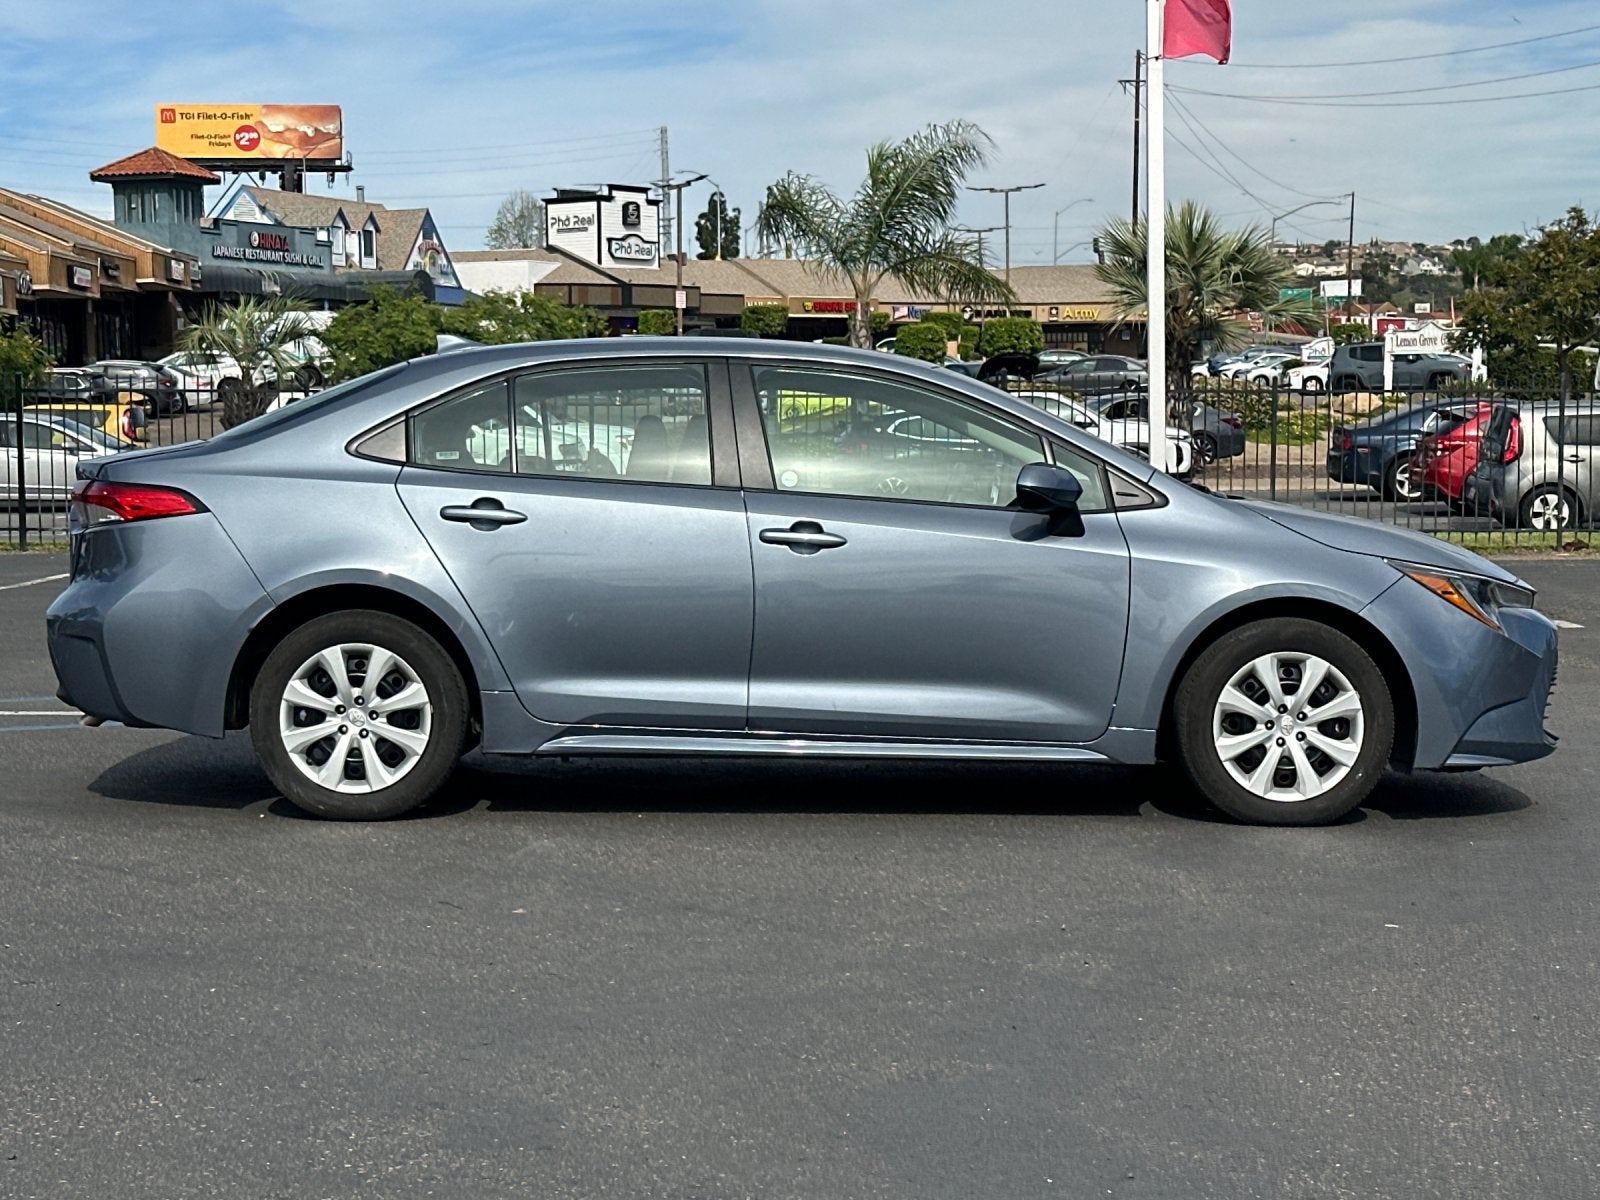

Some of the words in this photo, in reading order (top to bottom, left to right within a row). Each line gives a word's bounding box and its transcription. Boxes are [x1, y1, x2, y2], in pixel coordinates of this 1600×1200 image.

[179, 112, 195, 120] TGI
[573, 213, 595, 226] Real
[260, 232, 289, 251] HINATA
[213, 245, 245, 258] JAPANESE
[245, 248, 283, 262] RESTAURANT
[284, 252, 301, 264] SUSHI
[302, 254, 308, 264] &
[634, 244, 653, 257] Real
[1063, 307, 1100, 319] Army
[1396, 335, 1418, 347] Lemon
[1419, 334, 1438, 347] Grove
